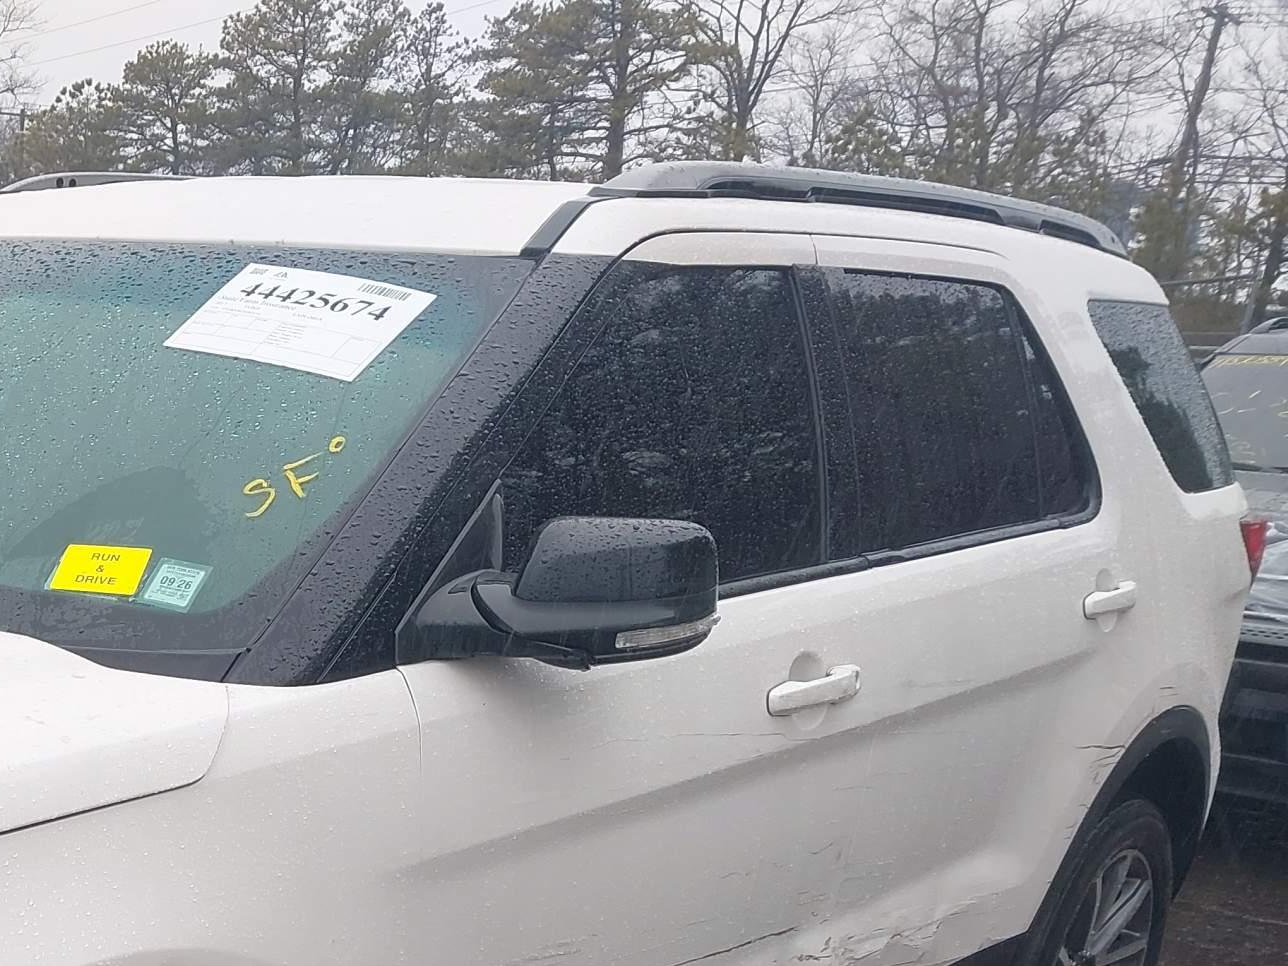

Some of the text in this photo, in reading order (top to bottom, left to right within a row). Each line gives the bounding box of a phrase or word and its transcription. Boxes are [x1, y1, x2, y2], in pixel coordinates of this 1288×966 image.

[240, 282, 392, 321] 44425674
[91, 552, 121, 562] RUN
[95, 565, 105, 573] &
[75, 574, 117, 585] DRIVE
